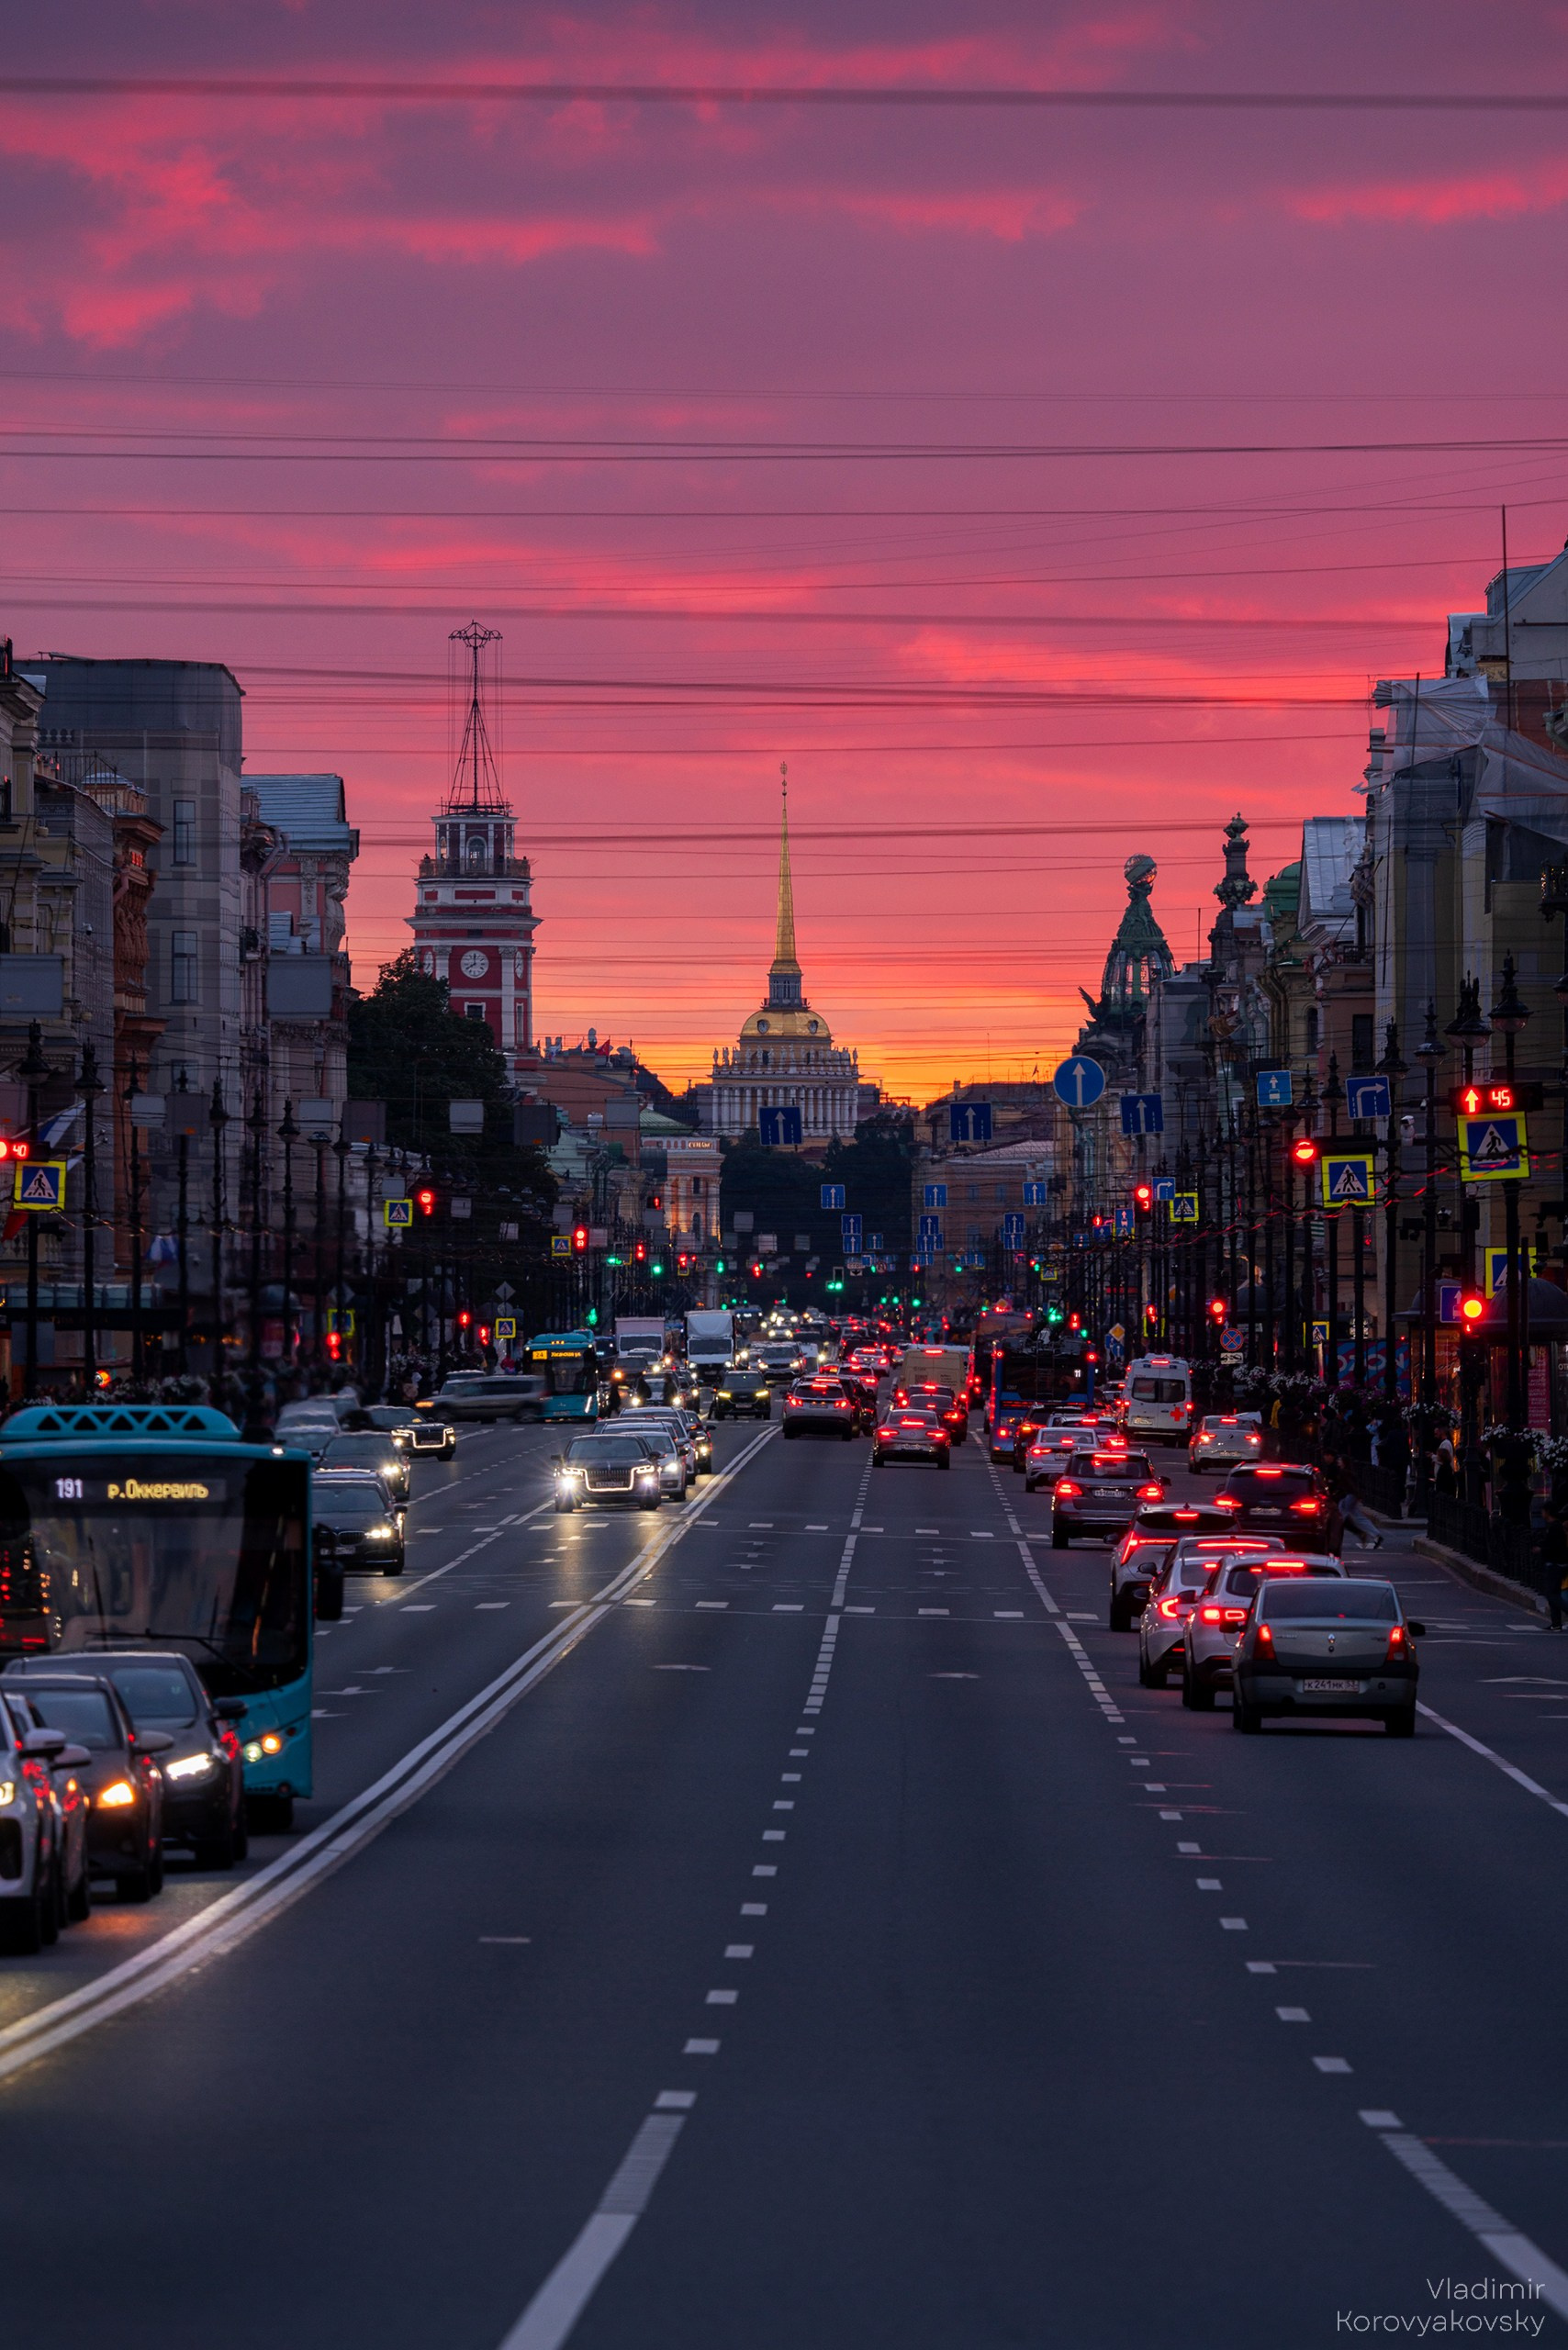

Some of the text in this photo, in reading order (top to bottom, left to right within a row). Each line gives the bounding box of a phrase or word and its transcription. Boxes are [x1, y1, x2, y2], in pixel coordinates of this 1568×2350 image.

[1492, 1091, 1510, 1107] 45
[12, 1144, 28, 1157] 40
[1074, 1370, 1081, 1378] 11
[55, 1478, 84, 1499] 191
